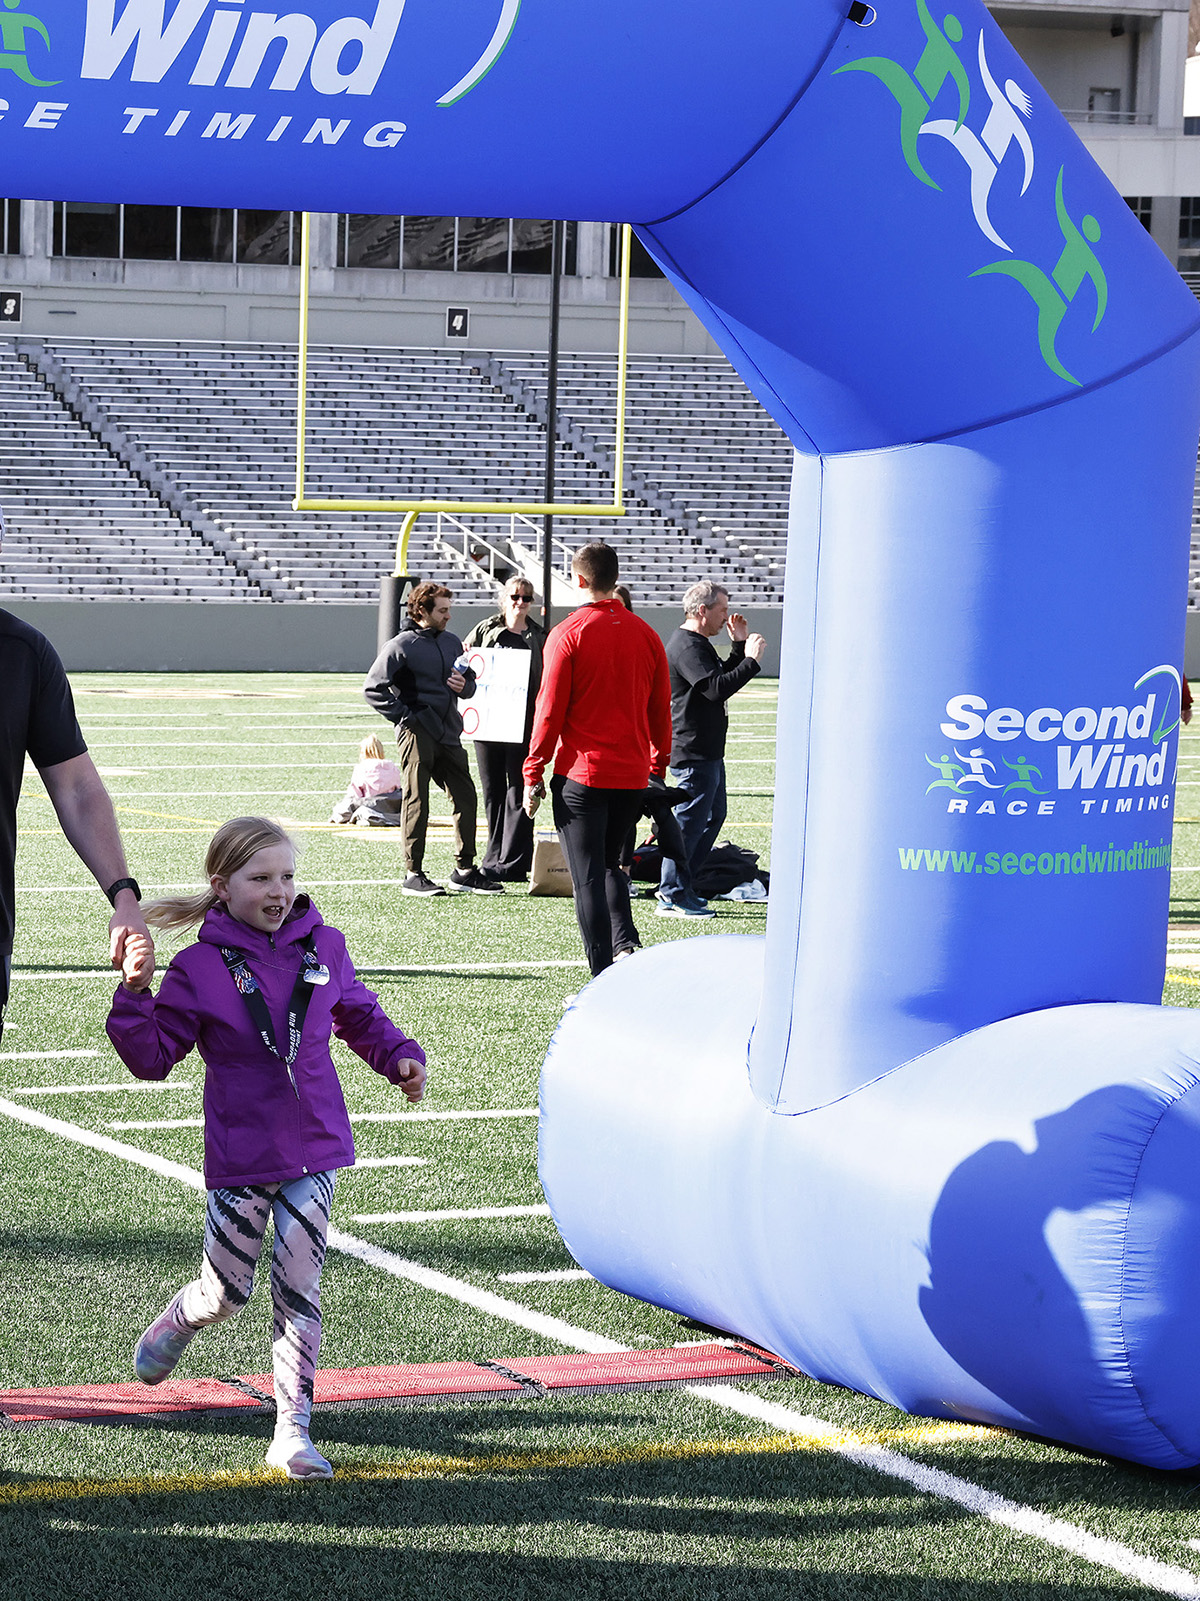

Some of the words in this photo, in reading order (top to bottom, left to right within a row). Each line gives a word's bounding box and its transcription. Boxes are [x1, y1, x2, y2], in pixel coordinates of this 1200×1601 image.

[79, 0, 403, 95] Wind
[121, 107, 408, 148] TIMING
[4, 299, 16, 315] 3
[452, 315, 464, 330] 4
[940, 694, 1156, 742] Second
[1057, 741, 1168, 790] Wind
[947, 798, 1056, 816] RACE
[1080, 794, 1170, 815] TIMING
